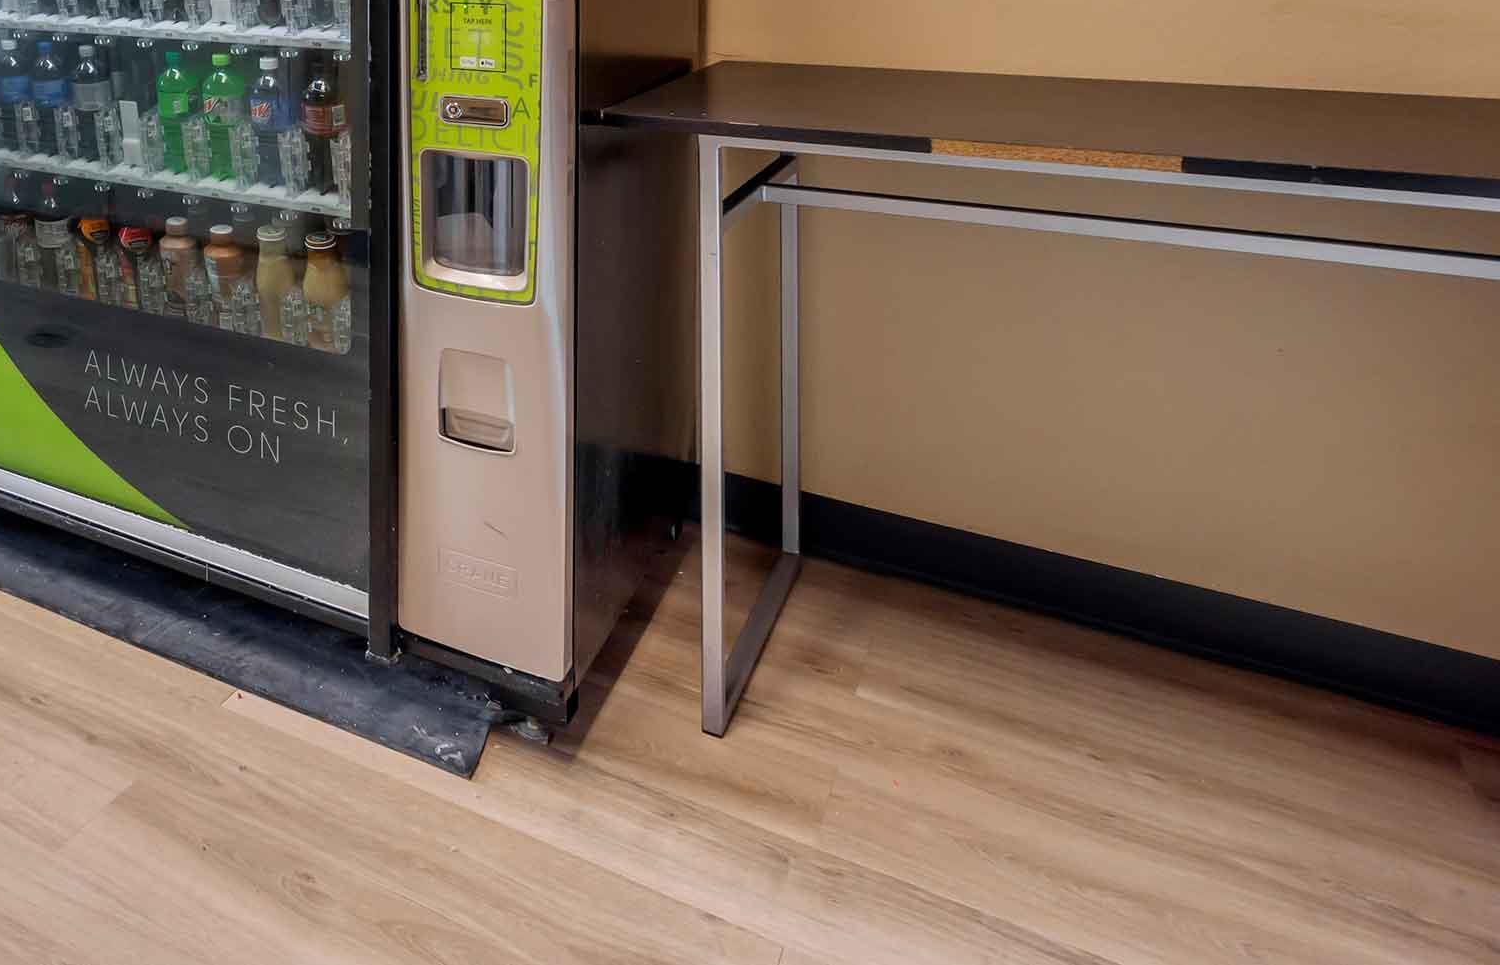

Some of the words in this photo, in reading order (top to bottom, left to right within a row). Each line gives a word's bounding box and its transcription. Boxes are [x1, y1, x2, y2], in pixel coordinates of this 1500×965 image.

[84, 348, 209, 405] ALWAYS
[228, 384, 348, 445] FRESH,
[84, 385, 209, 443] ALWAYS
[227, 425, 280, 464] ON
